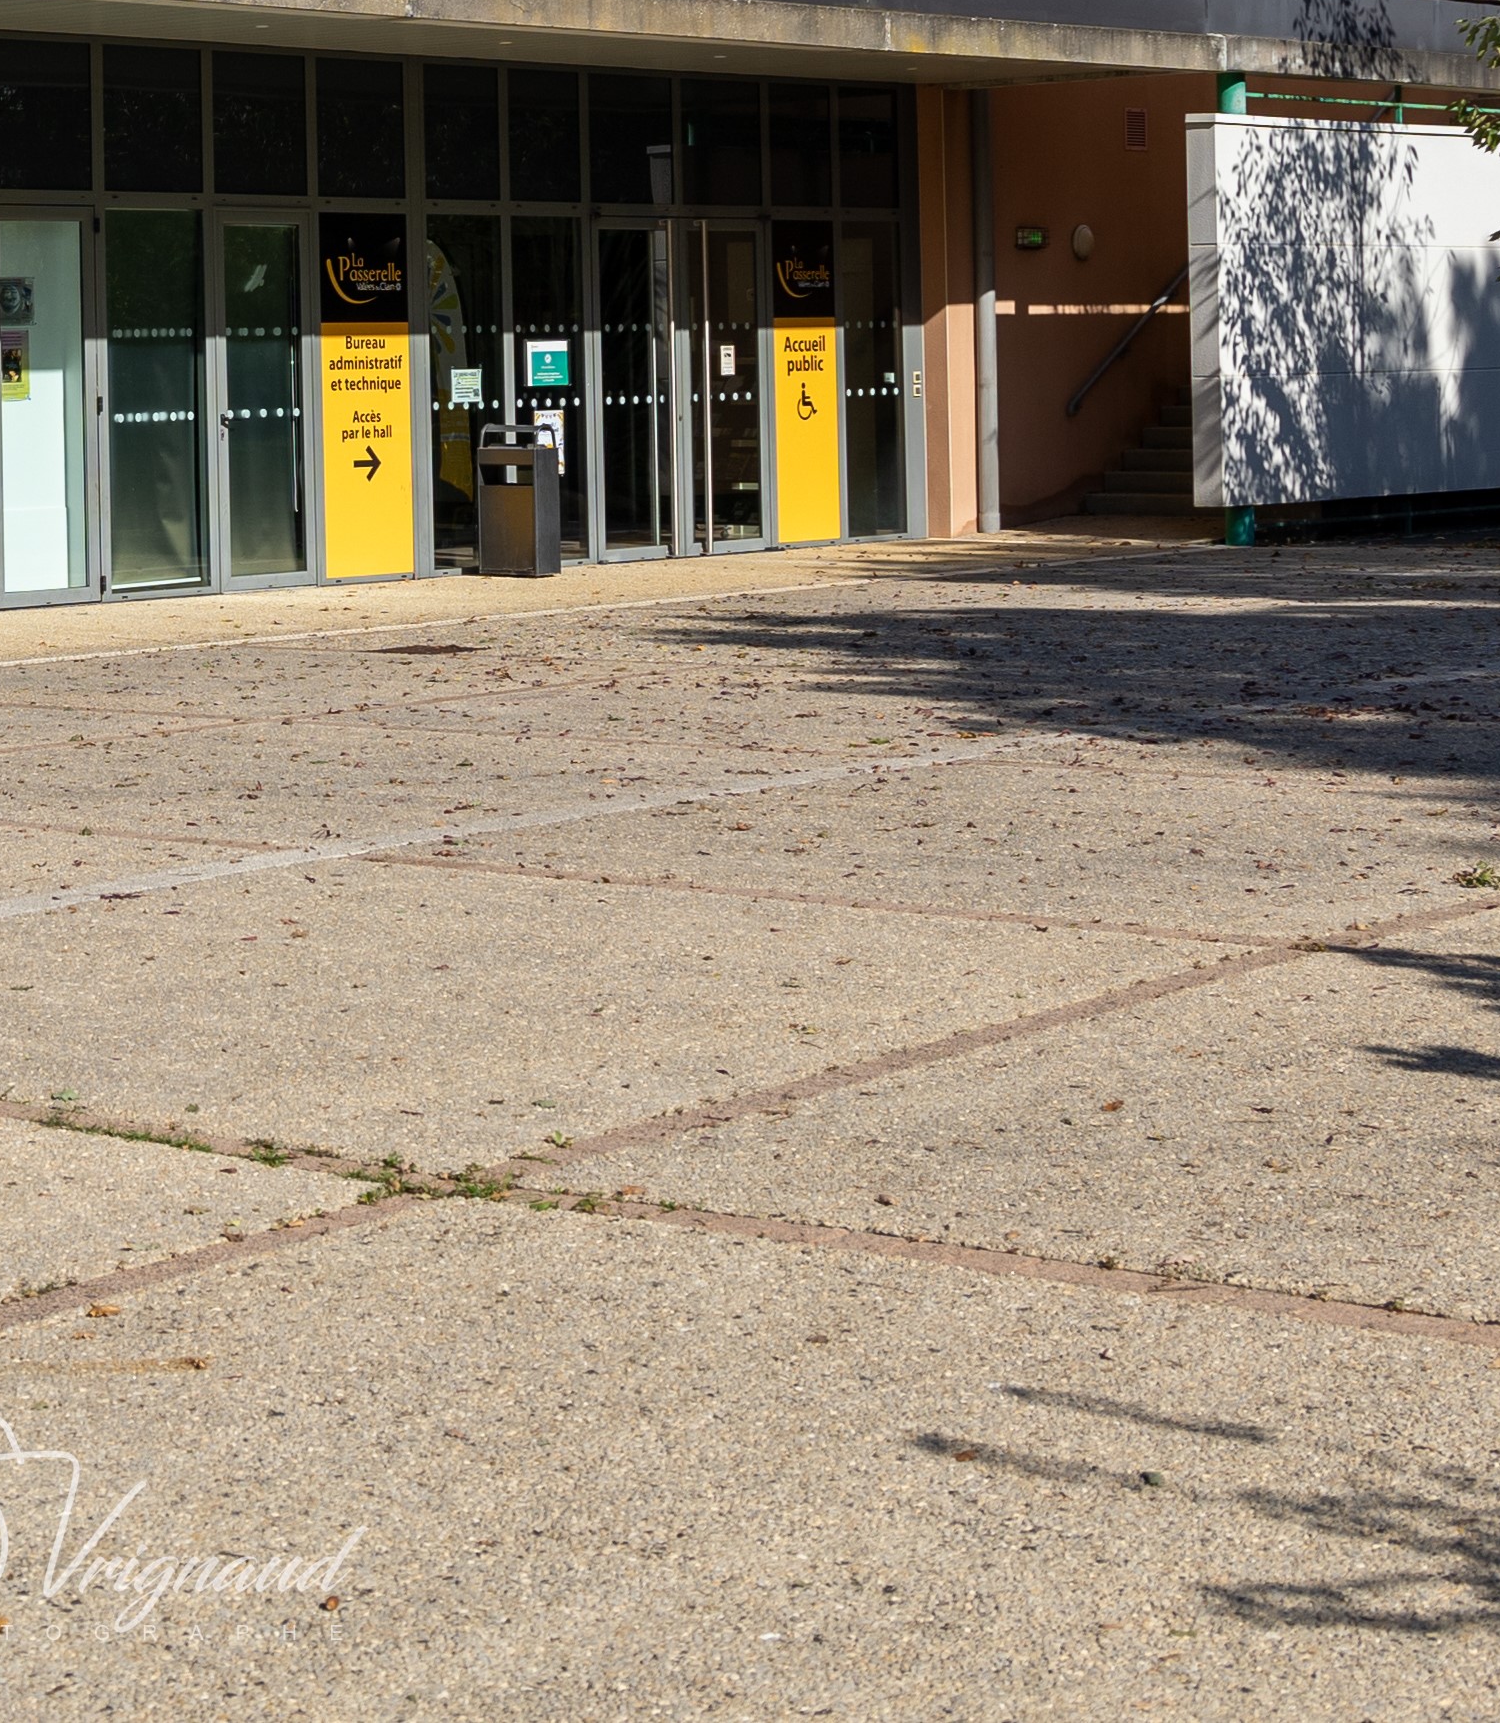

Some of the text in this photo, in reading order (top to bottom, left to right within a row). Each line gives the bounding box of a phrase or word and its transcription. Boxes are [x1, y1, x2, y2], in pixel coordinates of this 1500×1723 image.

[351, 252, 364, 267] La
[337, 256, 402, 282] Passerelle
[345, 335, 386, 350] Bureau
[784, 335, 826, 352] Accueil
[329, 355, 403, 370] administratif
[787, 355, 824, 377] public
[330, 376, 402, 393] et technique
[352, 409, 382, 423] Accès
[341, 424, 392, 443] par le hall
